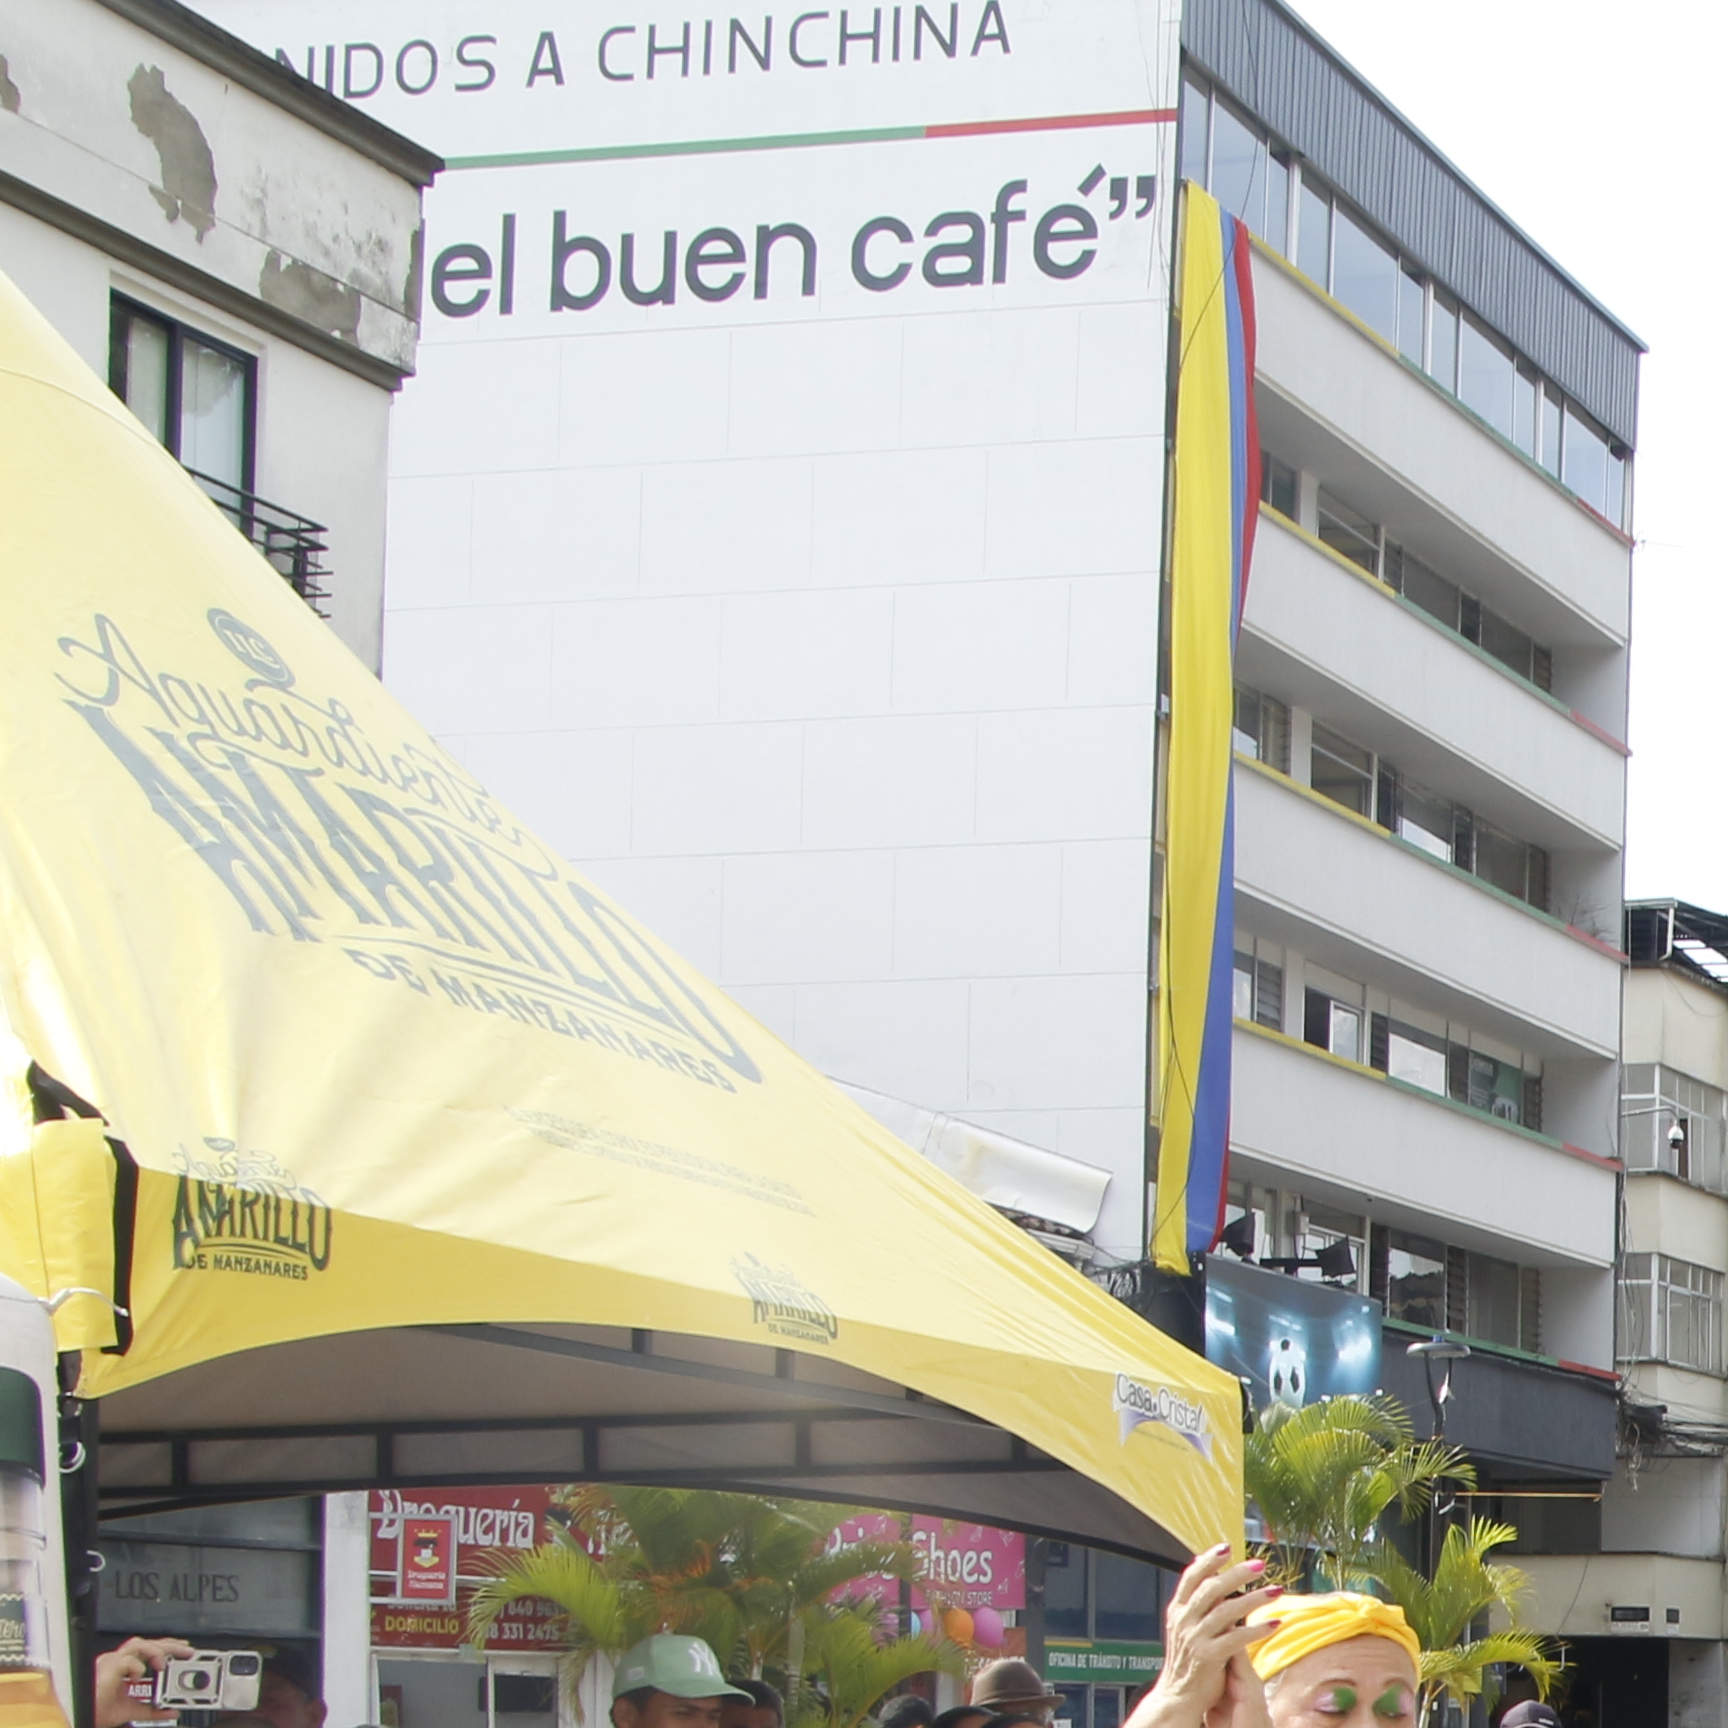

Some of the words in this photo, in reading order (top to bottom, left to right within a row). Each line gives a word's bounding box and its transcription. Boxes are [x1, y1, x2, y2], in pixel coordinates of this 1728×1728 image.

[526, 31, 565, 88] A
[598, 0, 1012, 82] CHINCHINA
[430, 213, 516, 318] el
[550, 209, 817, 313] buen
[342, 948, 430, 997] DE
[430, 967, 738, 1094] MANZANARES
[213, 1254, 309, 1281] MANZANARES
[378, 1489, 536, 1549] Duería
[911, 1530, 993, 1584] Shoes
[115, 1571, 160, 1600] LOS
[167, 1573, 240, 1603] ALPES
[385, 1615, 459, 1634] DOMICILIO
[1048, 1652, 1076, 1667] OFICINA
